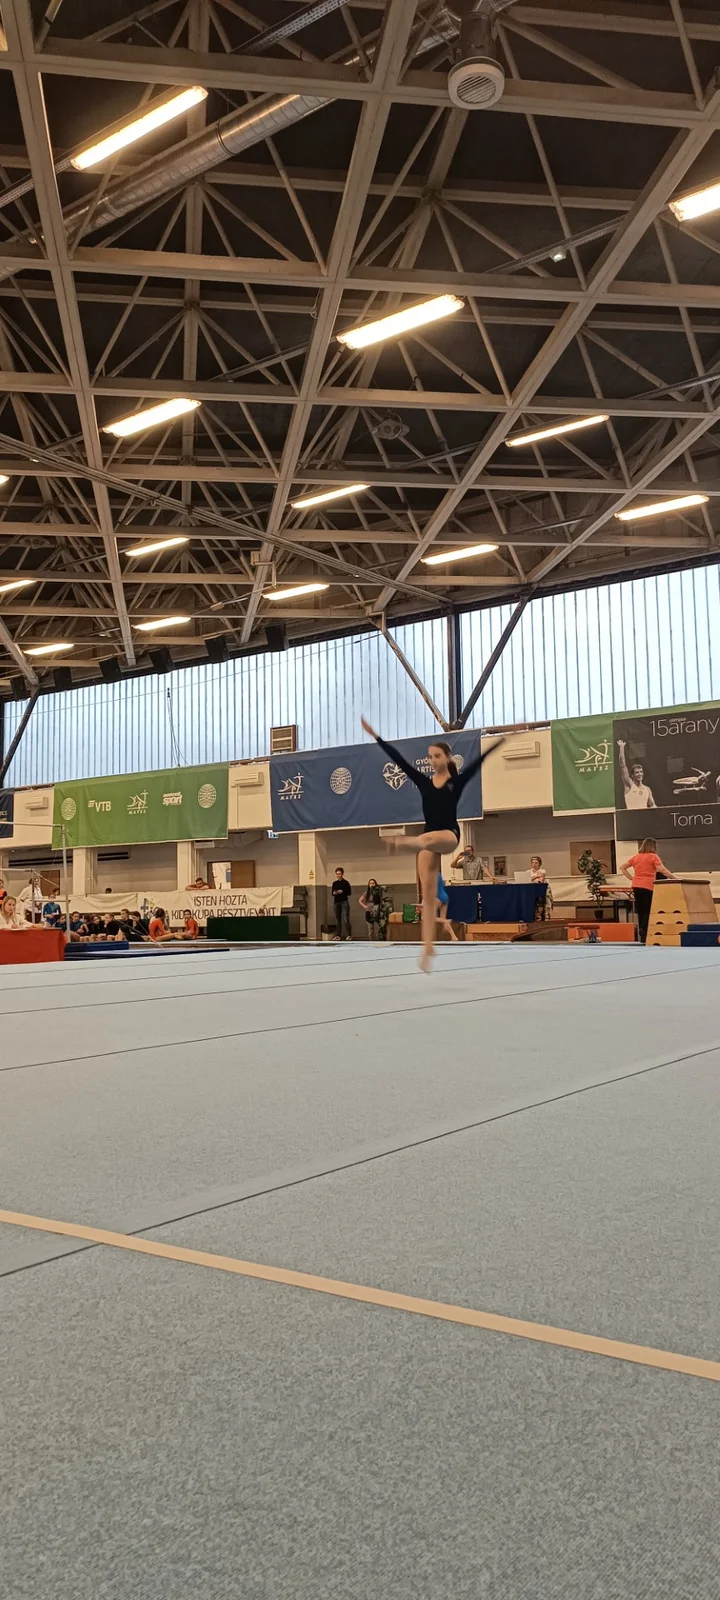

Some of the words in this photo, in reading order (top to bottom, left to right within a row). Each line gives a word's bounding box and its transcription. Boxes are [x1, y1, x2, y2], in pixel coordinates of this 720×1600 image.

[95, 801, 112, 812] VTB
[670, 812, 713, 827] Torna
[193, 896, 217, 906] ISTEN
[219, 895, 248, 905] HOZTA
[171, 909, 185, 920] KID
[192, 909, 215, 919] KUPA
